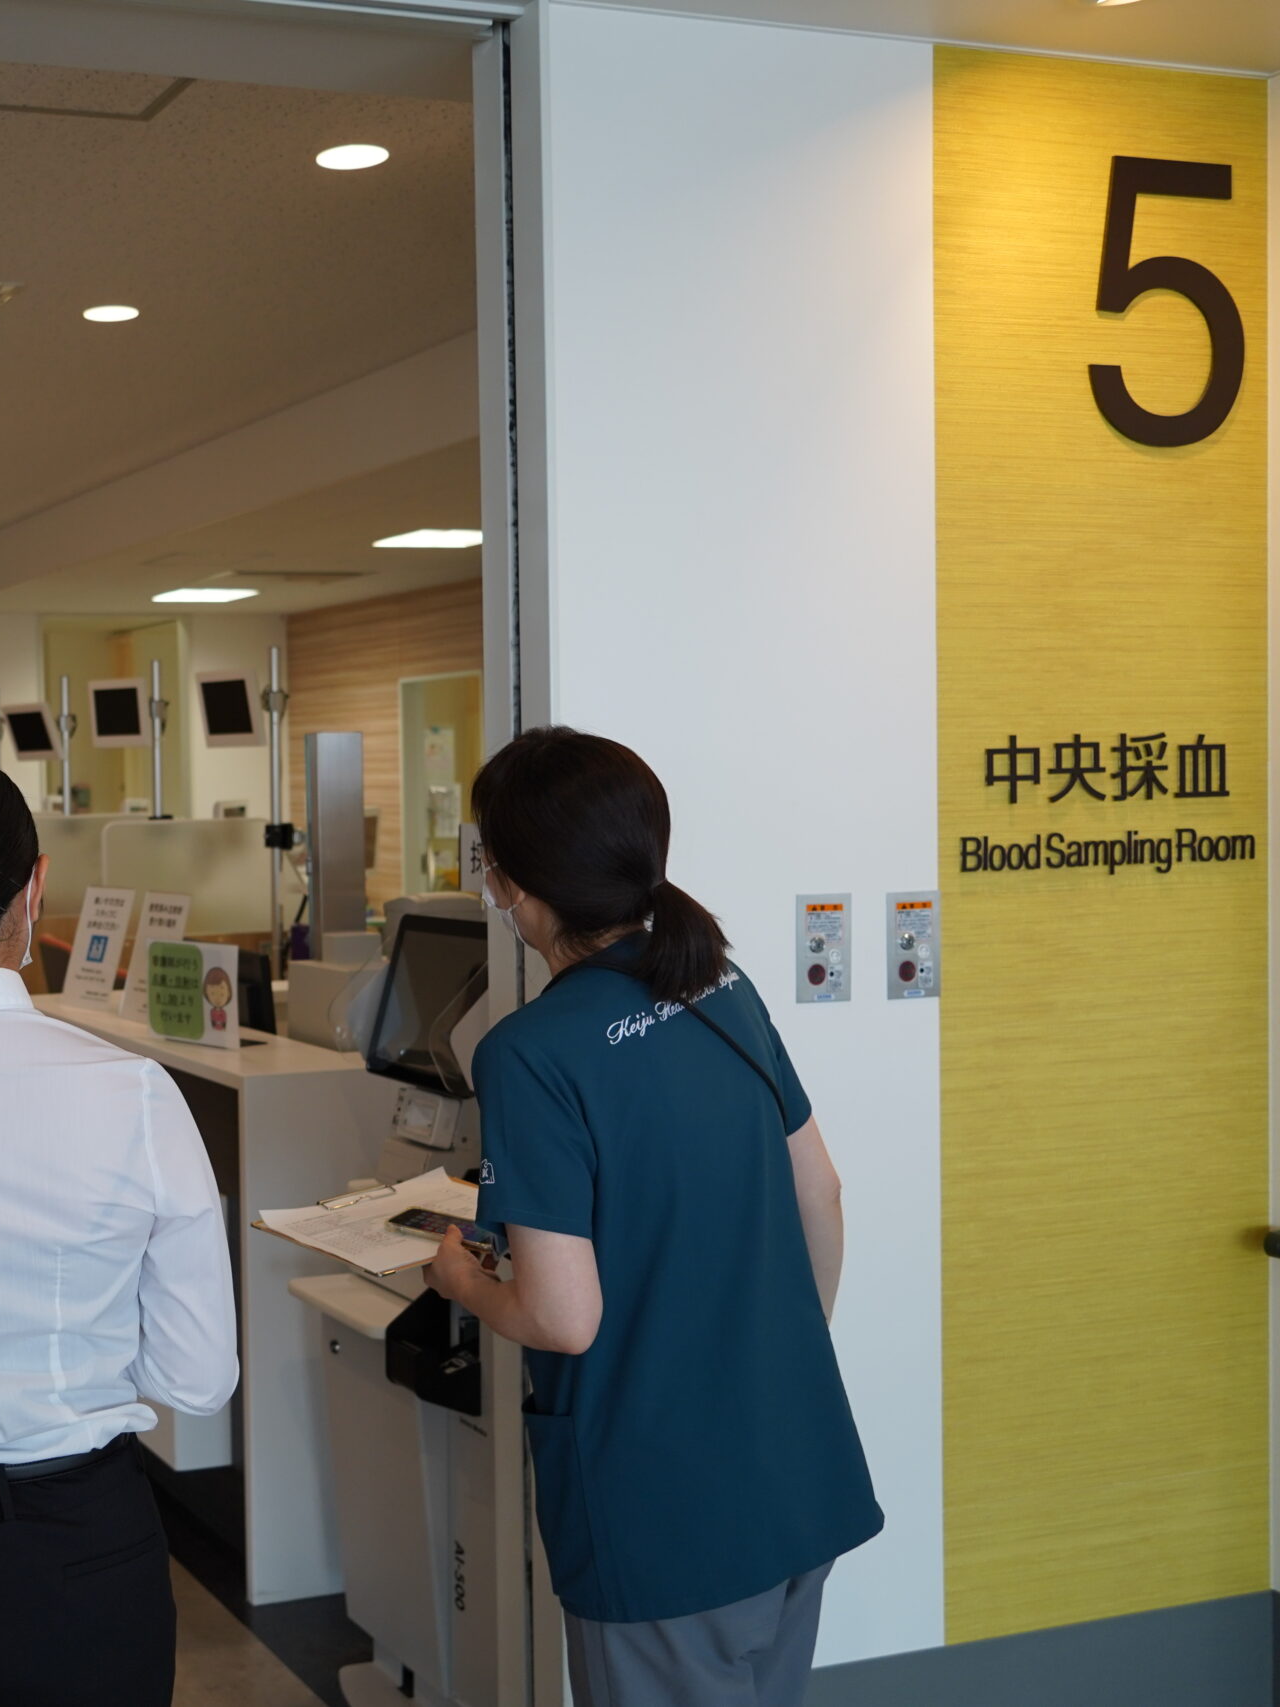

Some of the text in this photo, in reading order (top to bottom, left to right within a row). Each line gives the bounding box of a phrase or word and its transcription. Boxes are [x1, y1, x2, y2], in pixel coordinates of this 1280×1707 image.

[1088, 155, 1245, 448] 5
[984, 731, 1230, 805] 中央採血
[959, 827, 1256, 875] Blood Sampling Room
[606, 1010, 656, 1045] Keiju
